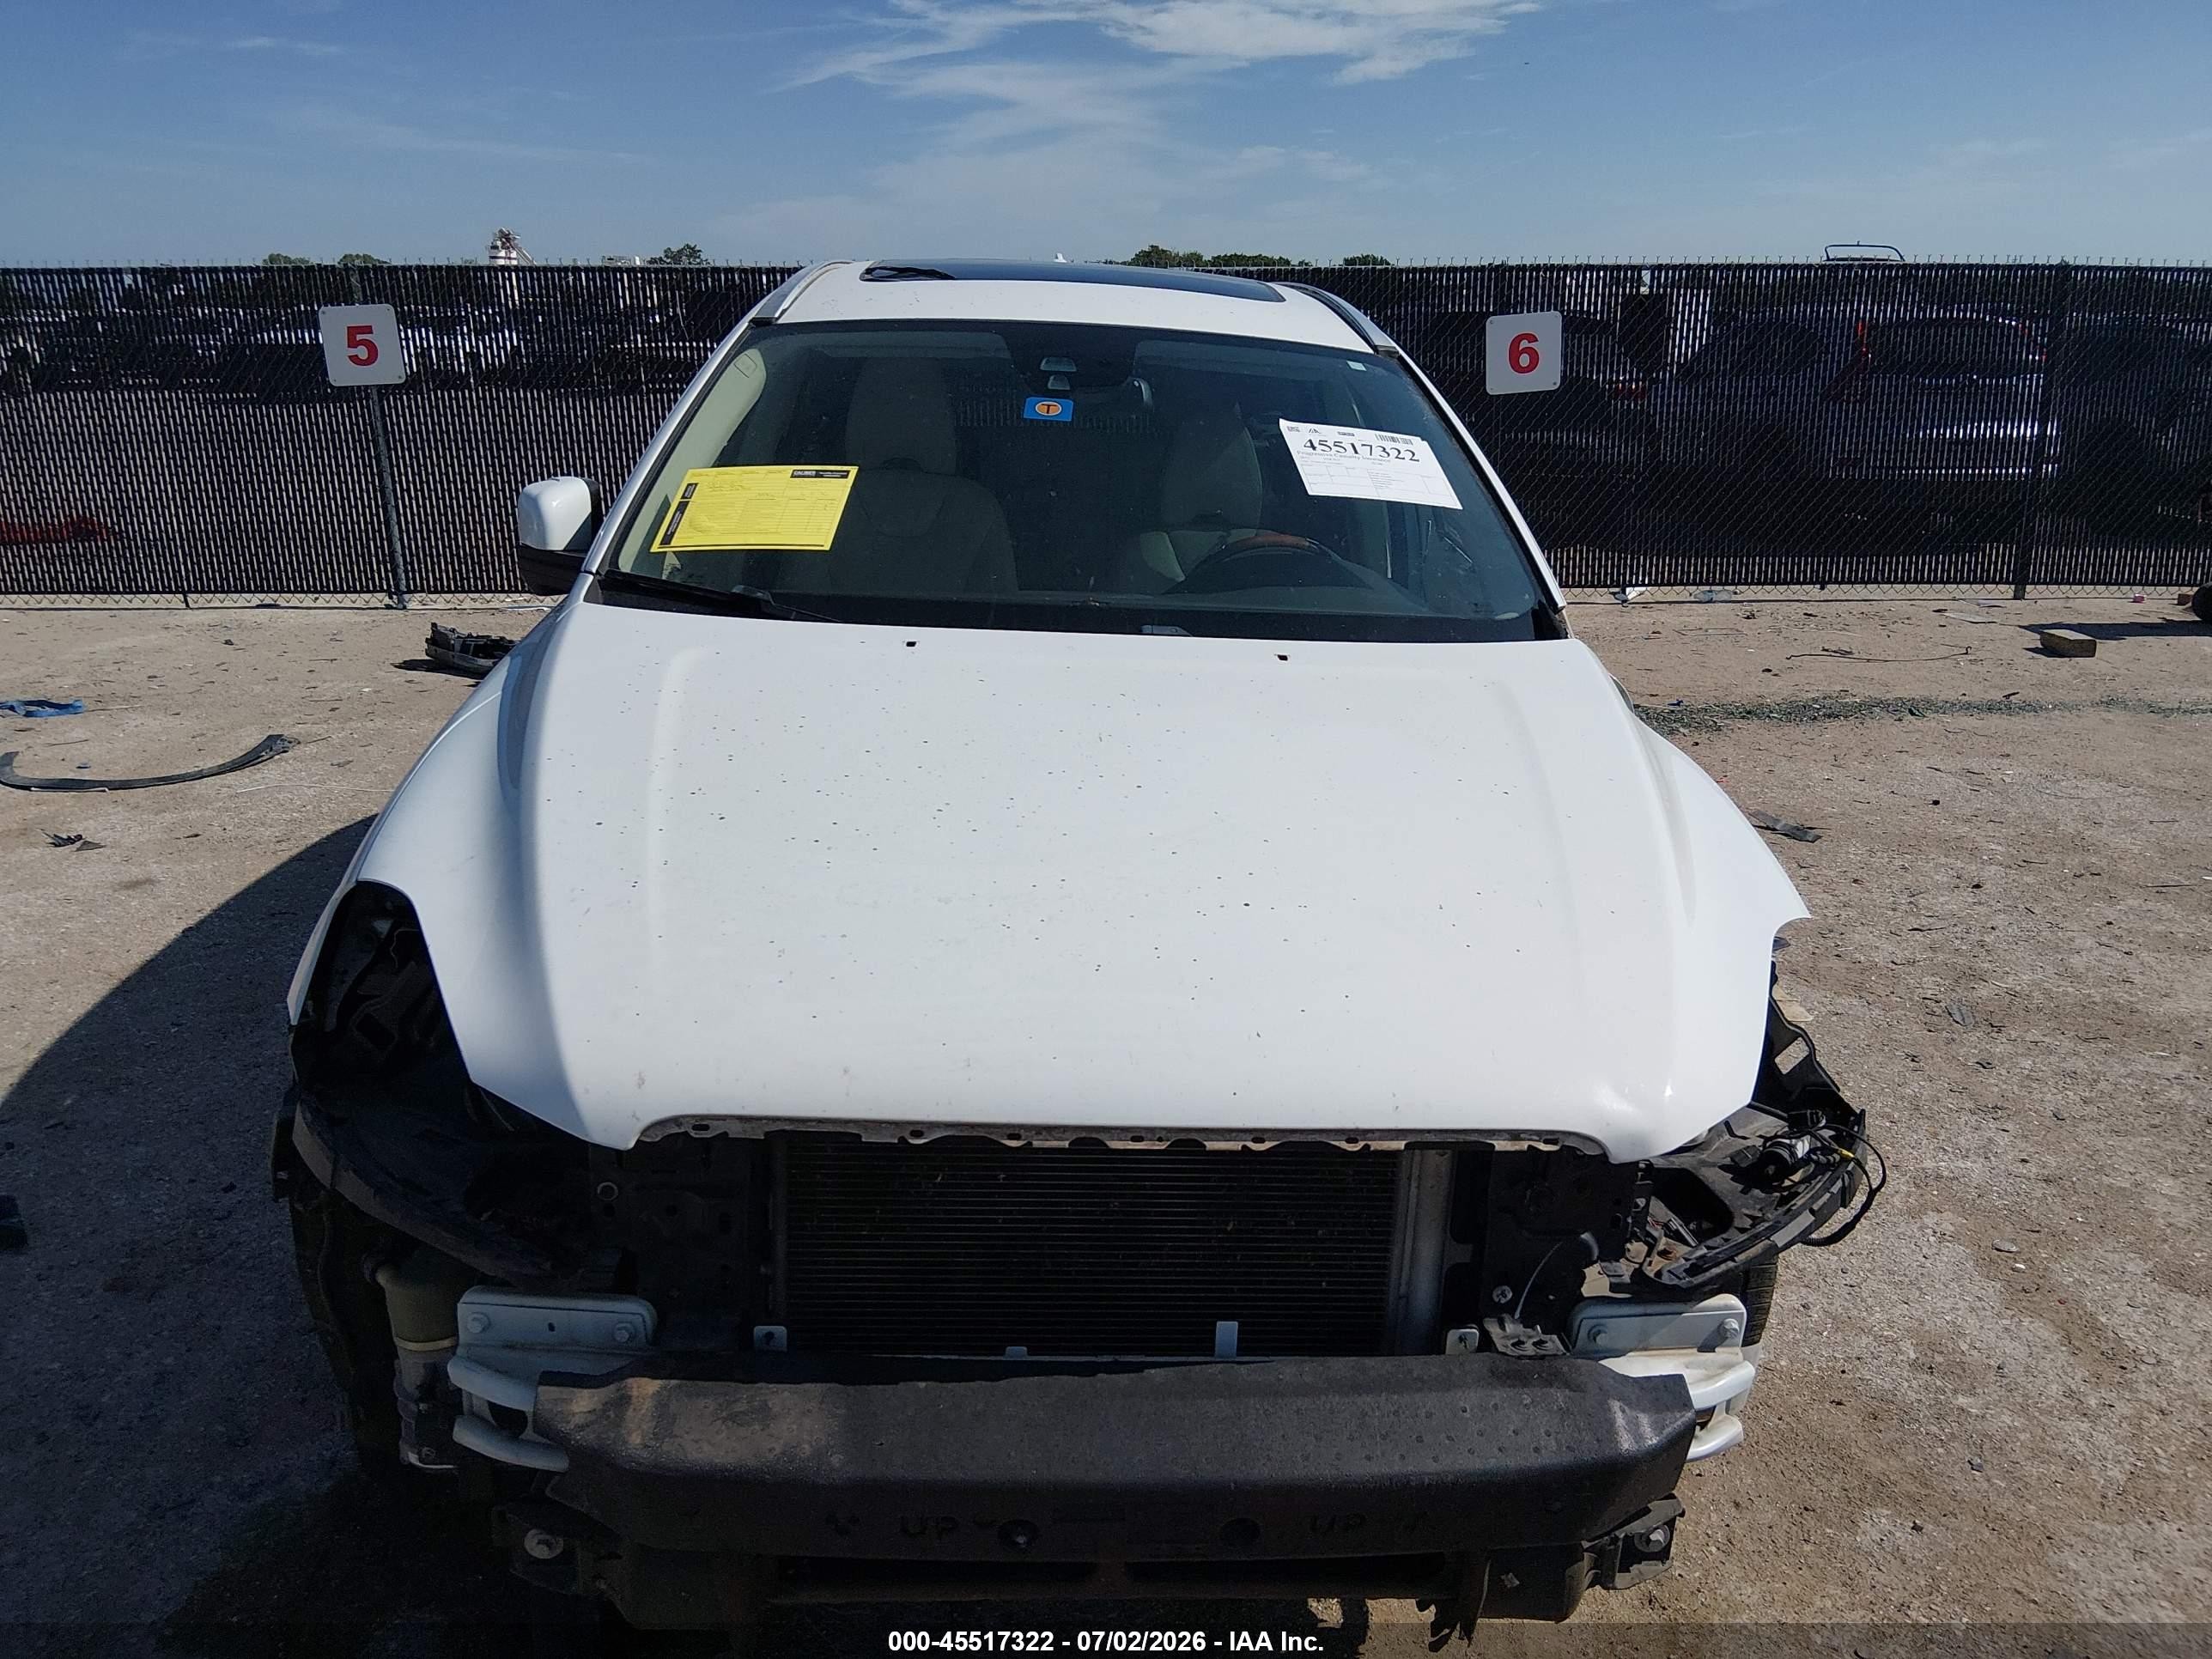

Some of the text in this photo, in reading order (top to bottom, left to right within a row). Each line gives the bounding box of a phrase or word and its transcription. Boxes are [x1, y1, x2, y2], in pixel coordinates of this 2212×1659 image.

[346, 325, 379, 367] 5
[1509, 332, 1540, 374] 6
[1042, 404, 1058, 414] T
[1304, 438, 1419, 462] 45517322
